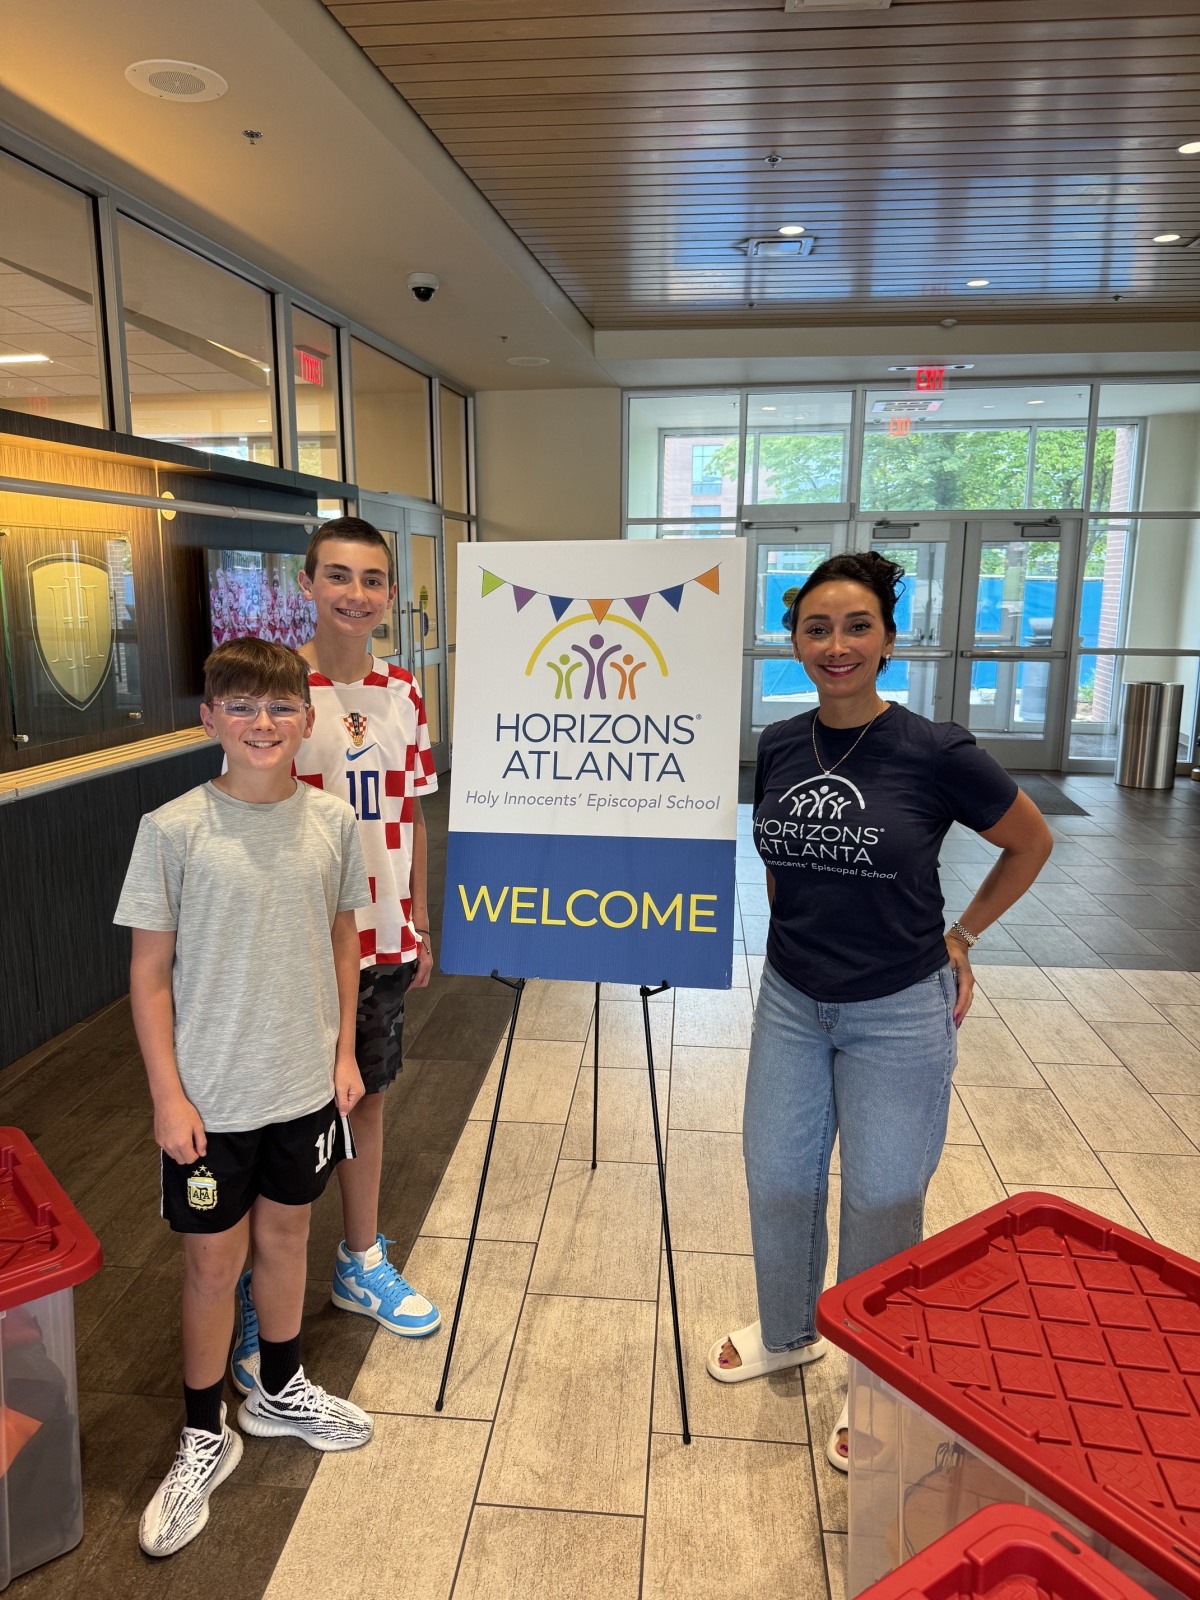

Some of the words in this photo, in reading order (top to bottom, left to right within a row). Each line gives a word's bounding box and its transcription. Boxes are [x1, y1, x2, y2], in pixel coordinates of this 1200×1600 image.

[915, 369, 945, 392] EXIT
[502, 750, 686, 783] ATLANTA
[346, 770, 381, 820] 10
[466, 790, 500, 808] Holy
[586, 793, 662, 813] Episcopal
[666, 795, 721, 810] School
[760, 837, 874, 866] ATLANTA
[811, 862, 858, 877] Episcopal
[861, 869, 898, 880] School
[458, 884, 718, 933] WELCOME
[315, 1119, 337, 1174] 10
